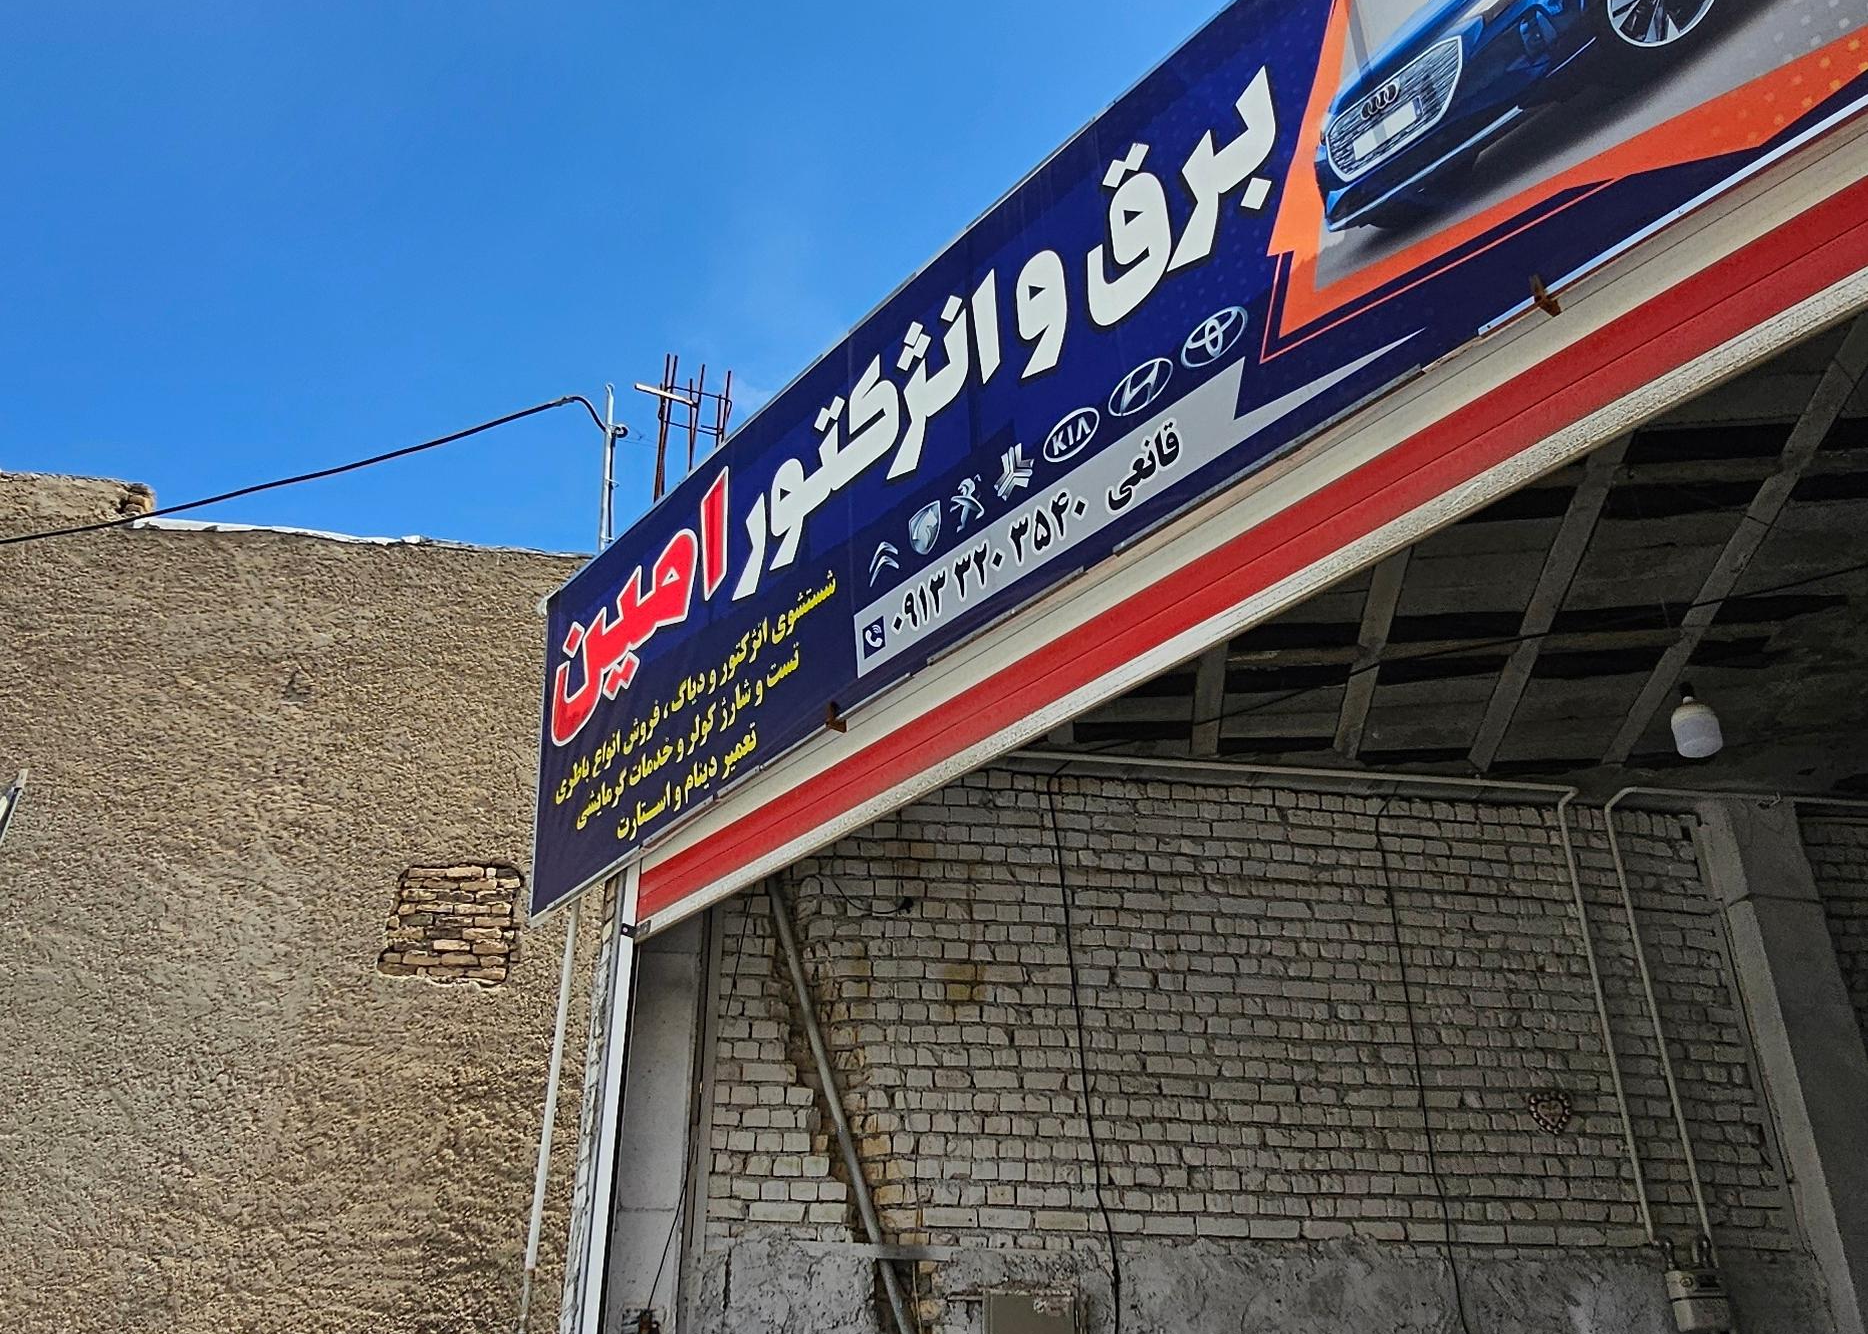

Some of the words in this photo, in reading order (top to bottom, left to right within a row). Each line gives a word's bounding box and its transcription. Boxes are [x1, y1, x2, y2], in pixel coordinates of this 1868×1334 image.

[1087, 67, 1276, 326] برق
[1017, 250, 1068, 379] و
[732, 269, 1001, 601] انژکتور
[1050, 415, 1093, 457] KIA
[1107, 420, 1181, 512] قانعی
[892, 569, 947, 632] ۰۹۱۳
[953, 541, 1004, 599] ۳۲۰
[1009, 491, 1087, 564] ۳۵۴۰
[551, 466, 728, 746] امین
[771, 569, 837, 645] شستشوی
[719, 616, 768, 687] انژکتور
[767, 641, 800, 688] تست
[708, 669, 717, 695] و
[719, 678, 751, 732] شارژ
[754, 679, 763, 707] و
[592, 729, 621, 778] انواع
[623, 700, 661, 755] فروش
[676, 737, 685, 763] و
[687, 701, 718, 756] کولر
[721, 722, 758, 780] تعمیر
[555, 755, 590, 805] باطری
[629, 737, 674, 786] خدمات
[684, 755, 718, 804] دینام
[616, 781, 671, 841] استارت
[673, 785, 682, 812] و
